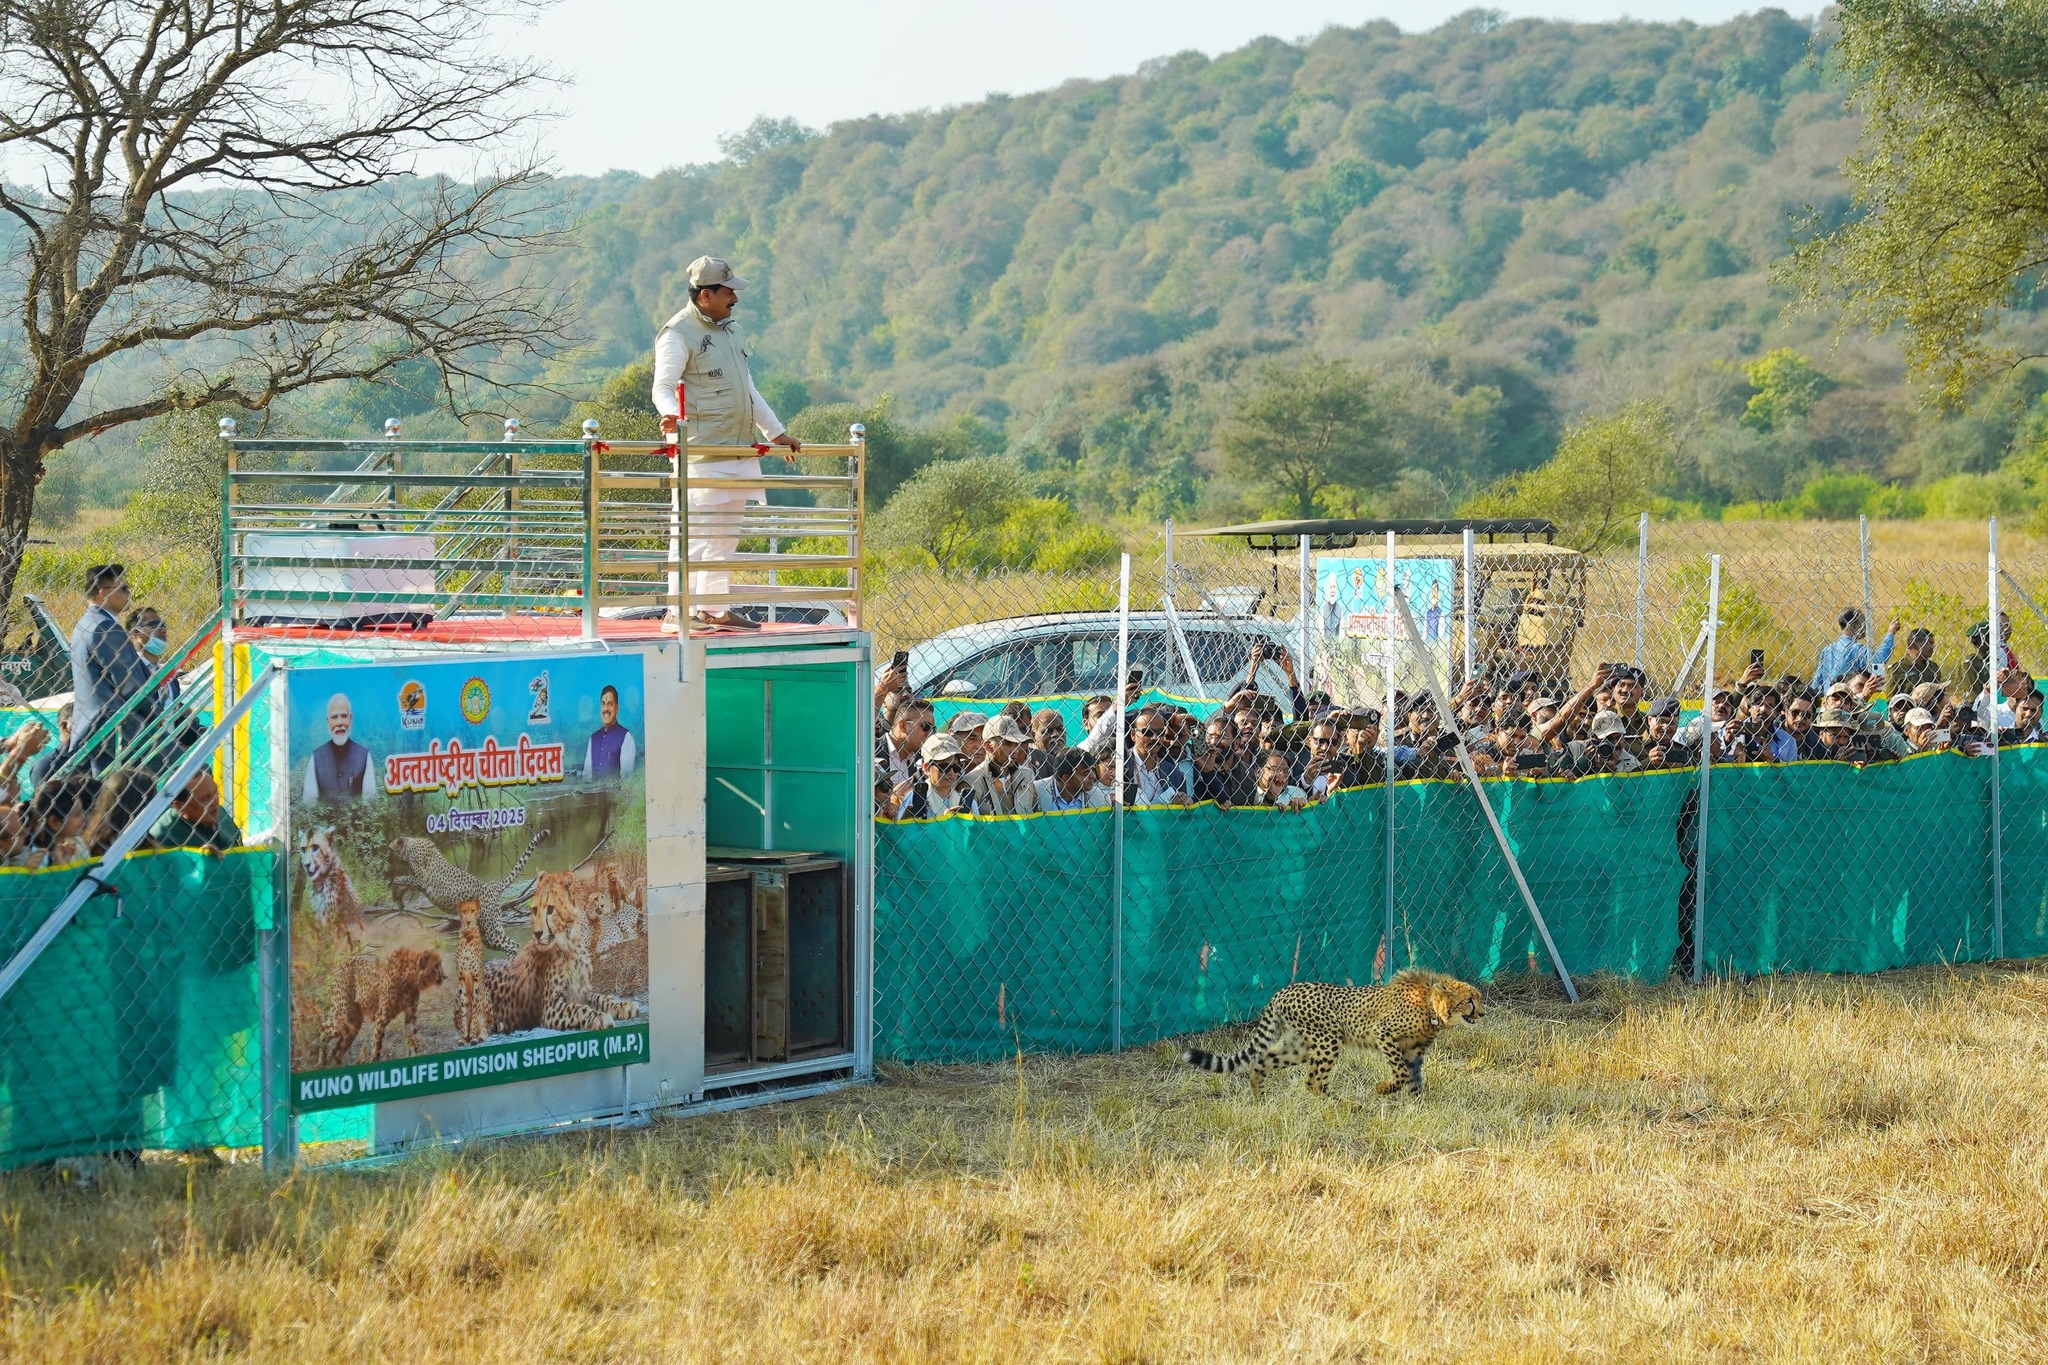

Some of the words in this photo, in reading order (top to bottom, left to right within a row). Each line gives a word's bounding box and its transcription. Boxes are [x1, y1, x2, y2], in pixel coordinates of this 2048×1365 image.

[386, 741, 476, 789] अन्तर्राष्ट्रीय
[478, 738, 516, 779] चीता
[519, 735, 562, 778] दिवस
[428, 815, 445, 831] 04
[449, 809, 489, 831] दिसम्बर
[493, 808, 525, 826] 2025
[300, 1075, 354, 1100] KUNO
[357, 1062, 439, 1092] WILDLIFE
[443, 1051, 518, 1080] DIVISION
[522, 1039, 599, 1068] SHEOPUR
[603, 1032, 643, 1060] (M.P.)
